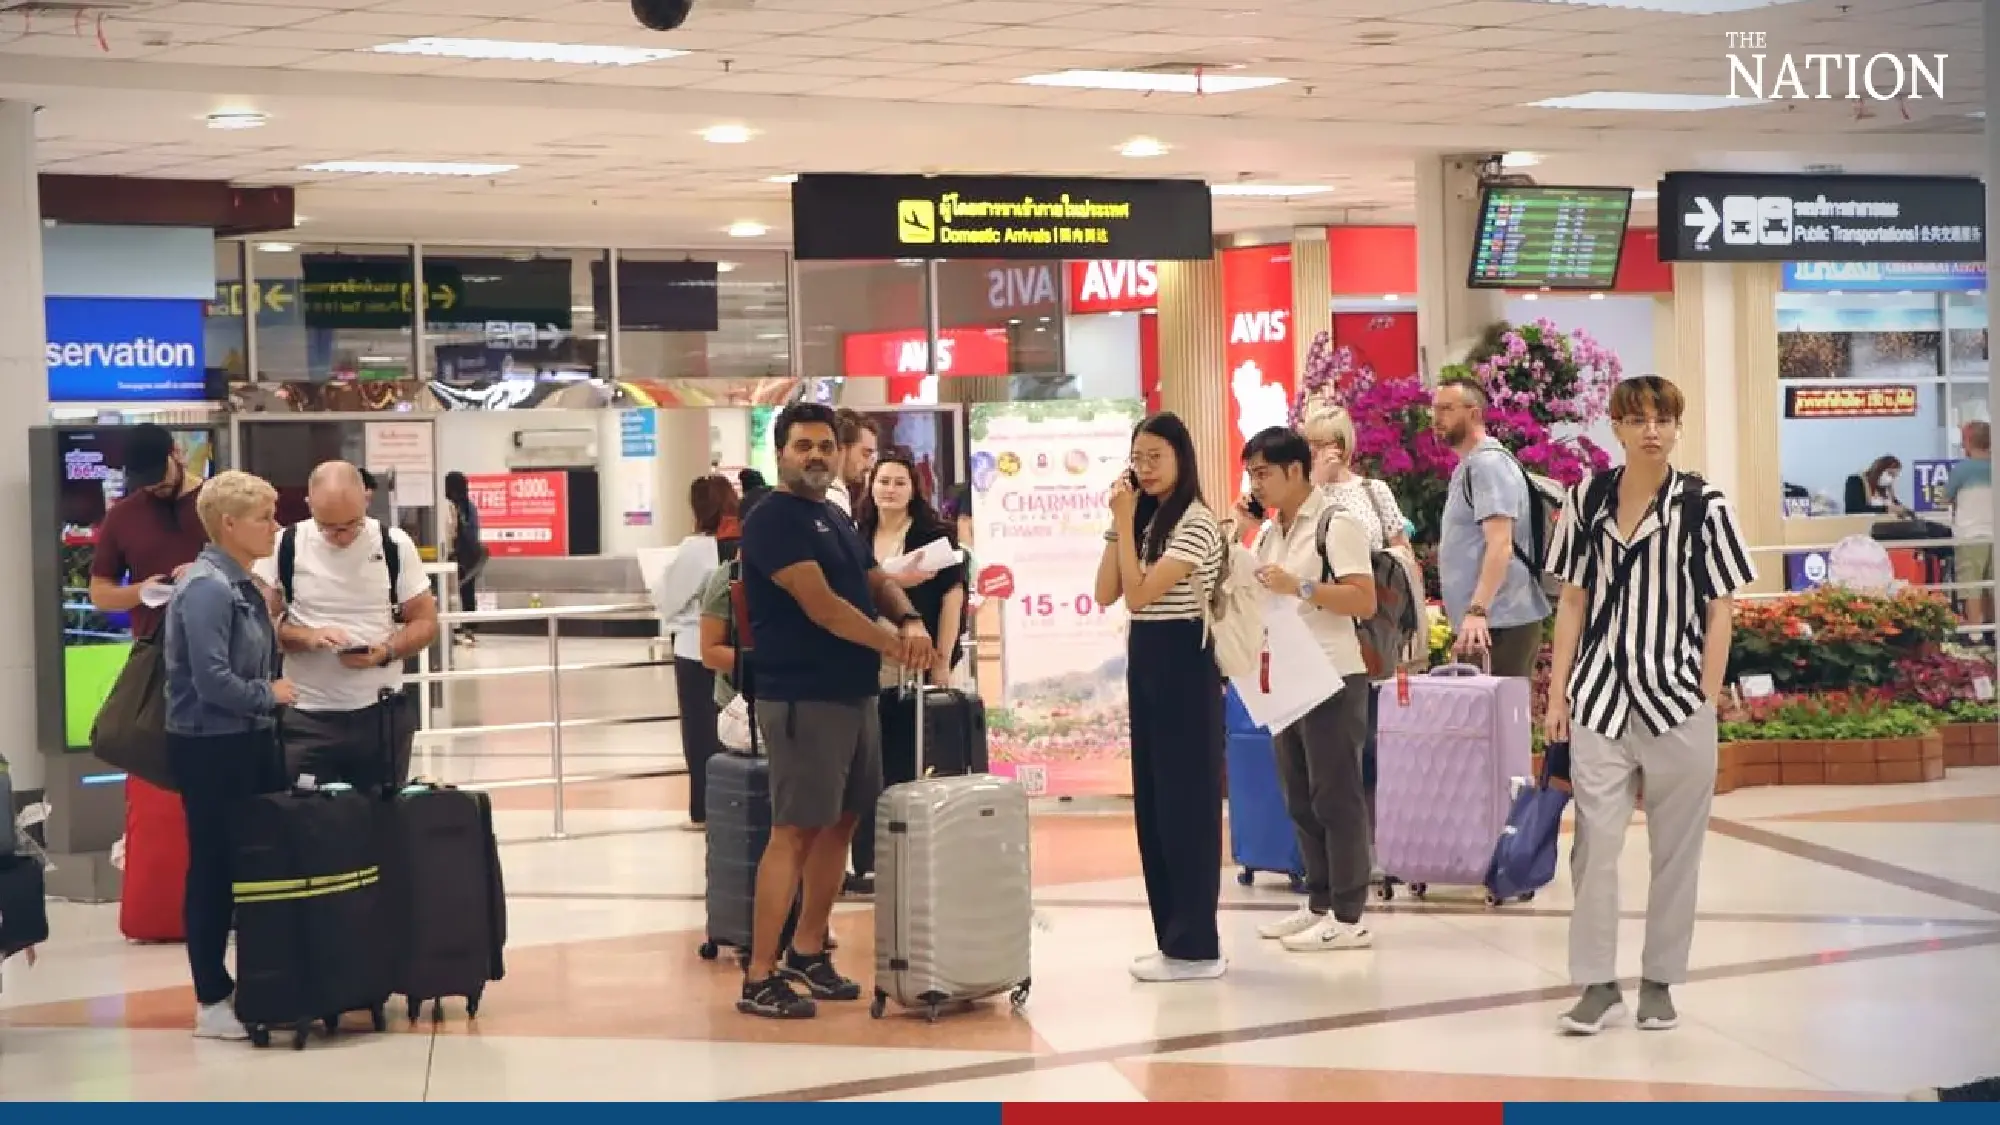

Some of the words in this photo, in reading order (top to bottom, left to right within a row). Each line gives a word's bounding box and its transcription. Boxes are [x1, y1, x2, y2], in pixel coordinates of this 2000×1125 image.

[940, 228, 1000, 243] Domestic
[1004, 228, 1051, 243] Arrivals
[1794, 225, 1829, 243] Public
[1080, 260, 1157, 301] AVIS
[1231, 310, 1286, 343] AVIS
[46, 336, 195, 367] servation
[1915, 465, 1955, 486] TA
[1021, 594, 1053, 616] 15
